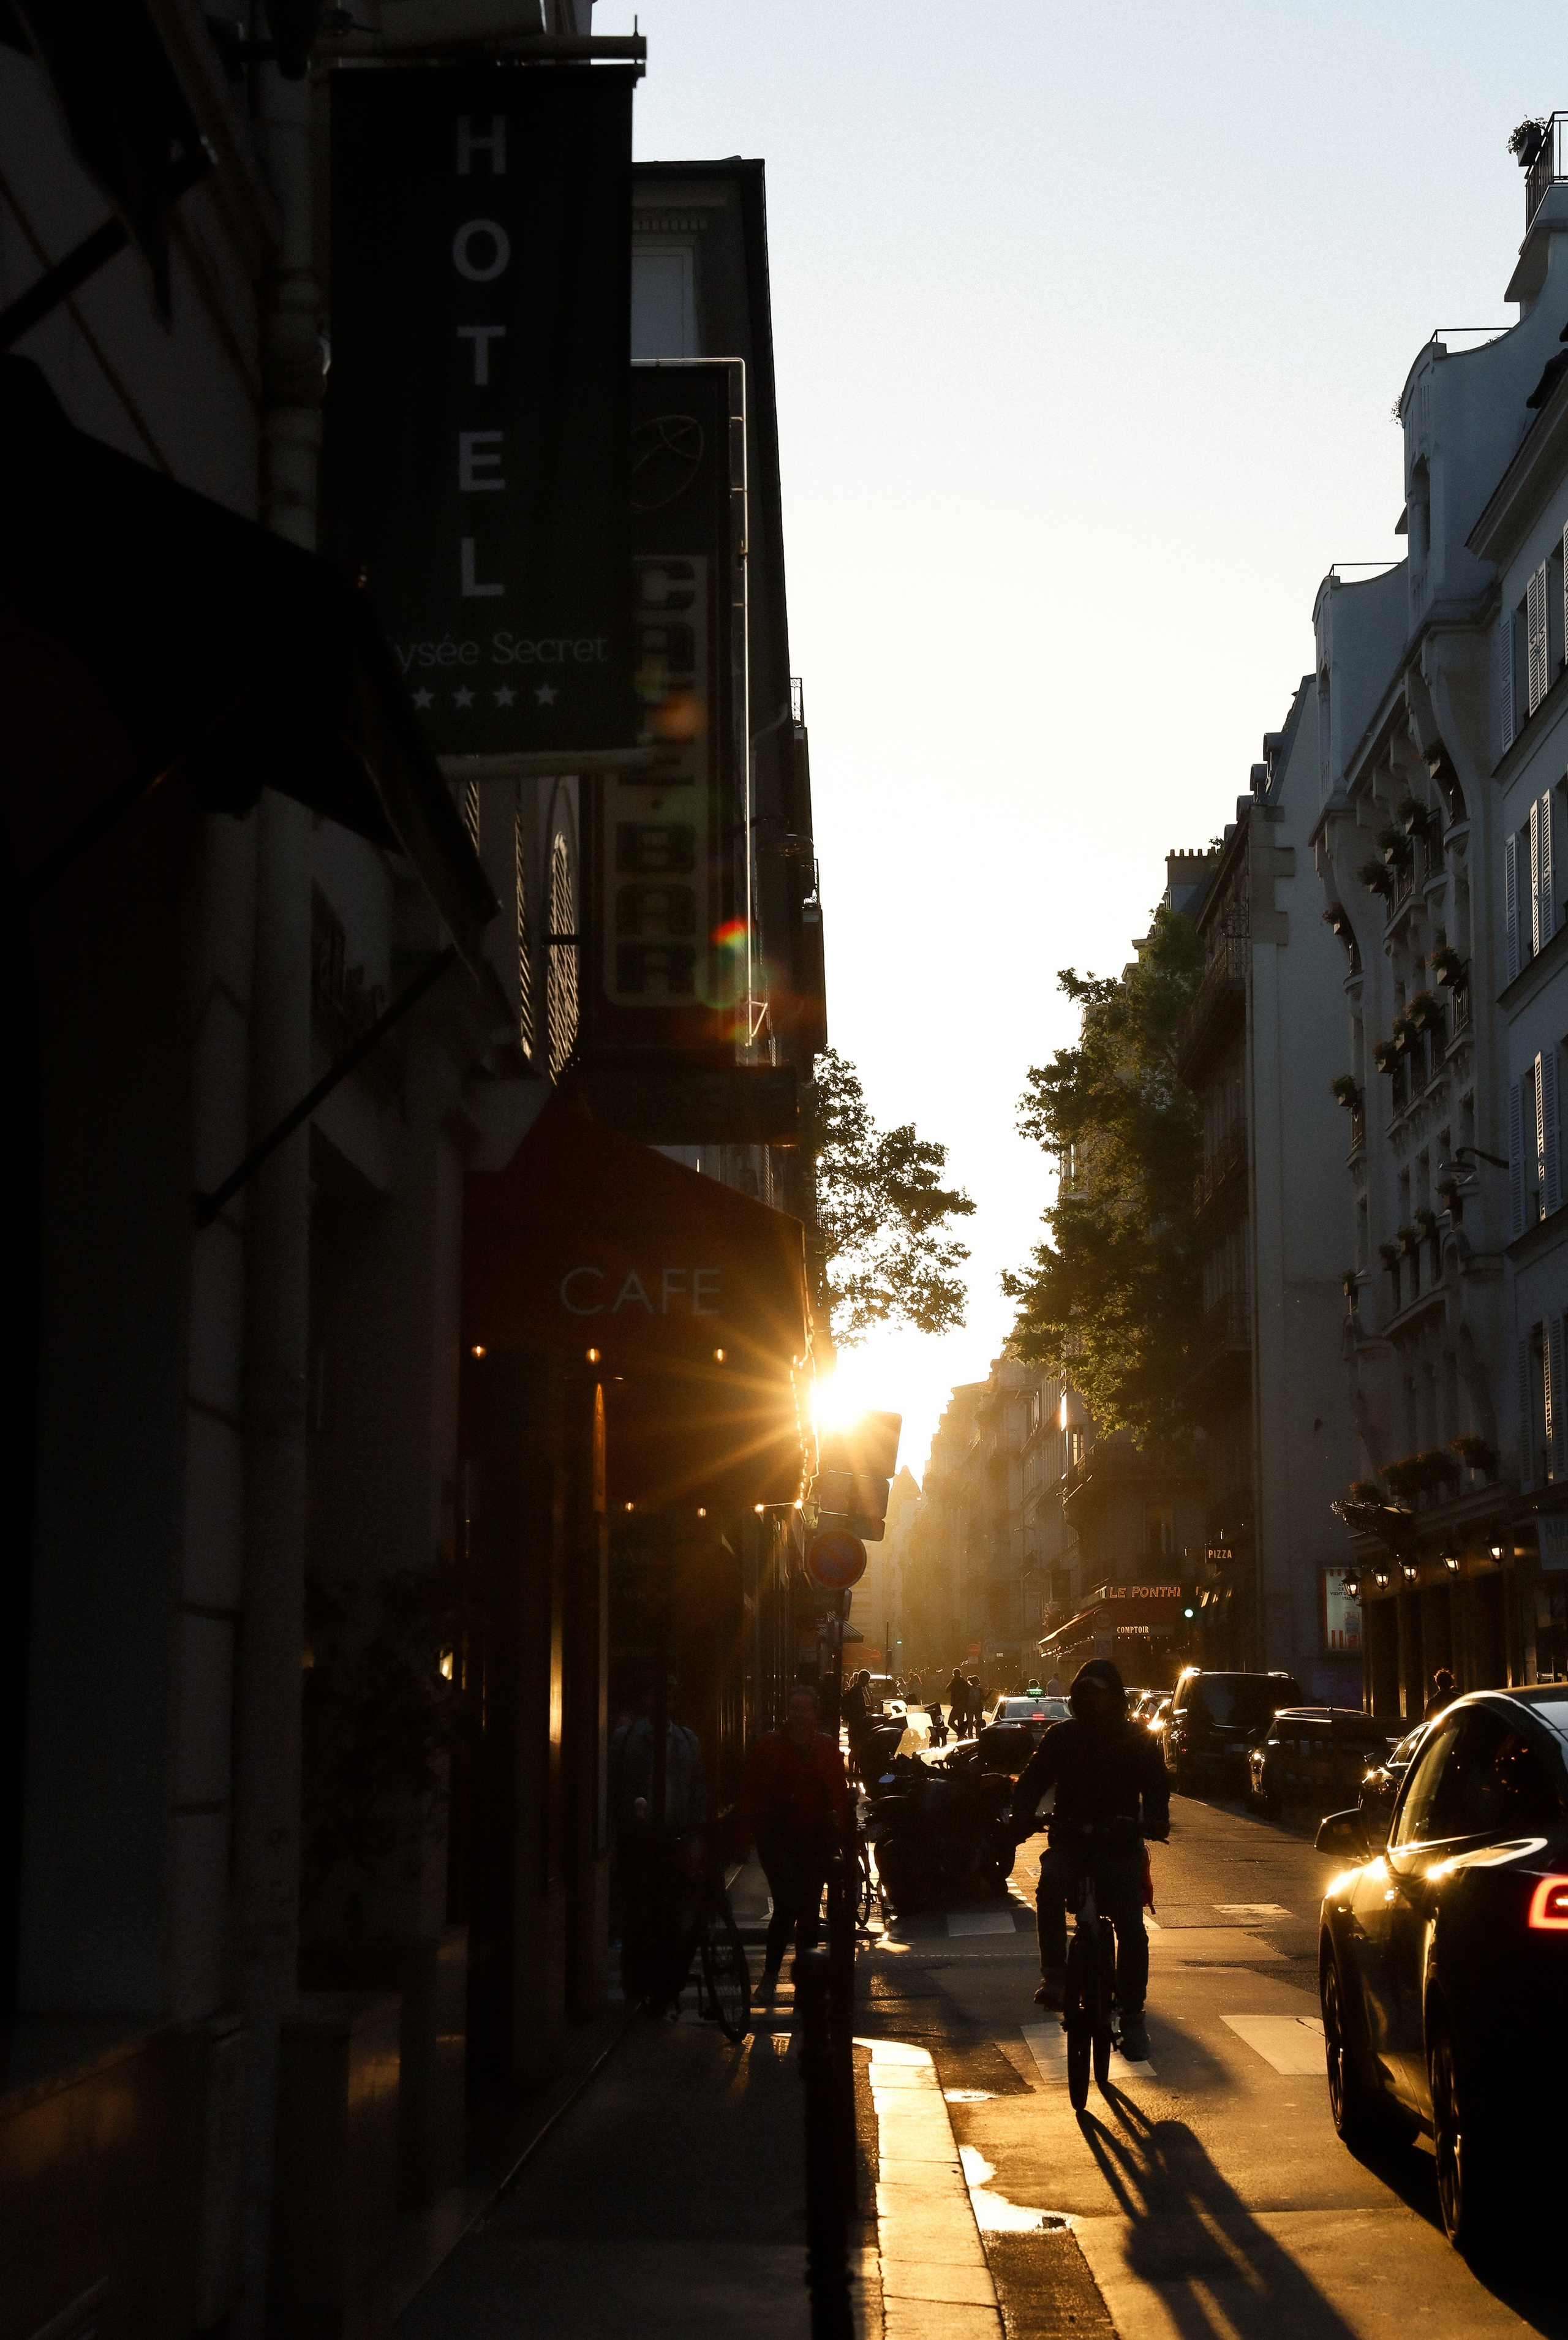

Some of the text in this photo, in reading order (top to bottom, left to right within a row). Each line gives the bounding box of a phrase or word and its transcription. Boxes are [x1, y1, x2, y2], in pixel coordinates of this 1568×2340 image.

[451, 115, 511, 597] HOTEL
[388, 631, 609, 674] ysée Secret
[616, 821, 697, 995] BAR
[559, 1266, 723, 1316] CAFE
[1208, 1549, 1232, 1559] PIZZA
[1109, 1587, 1126, 1598] LE
